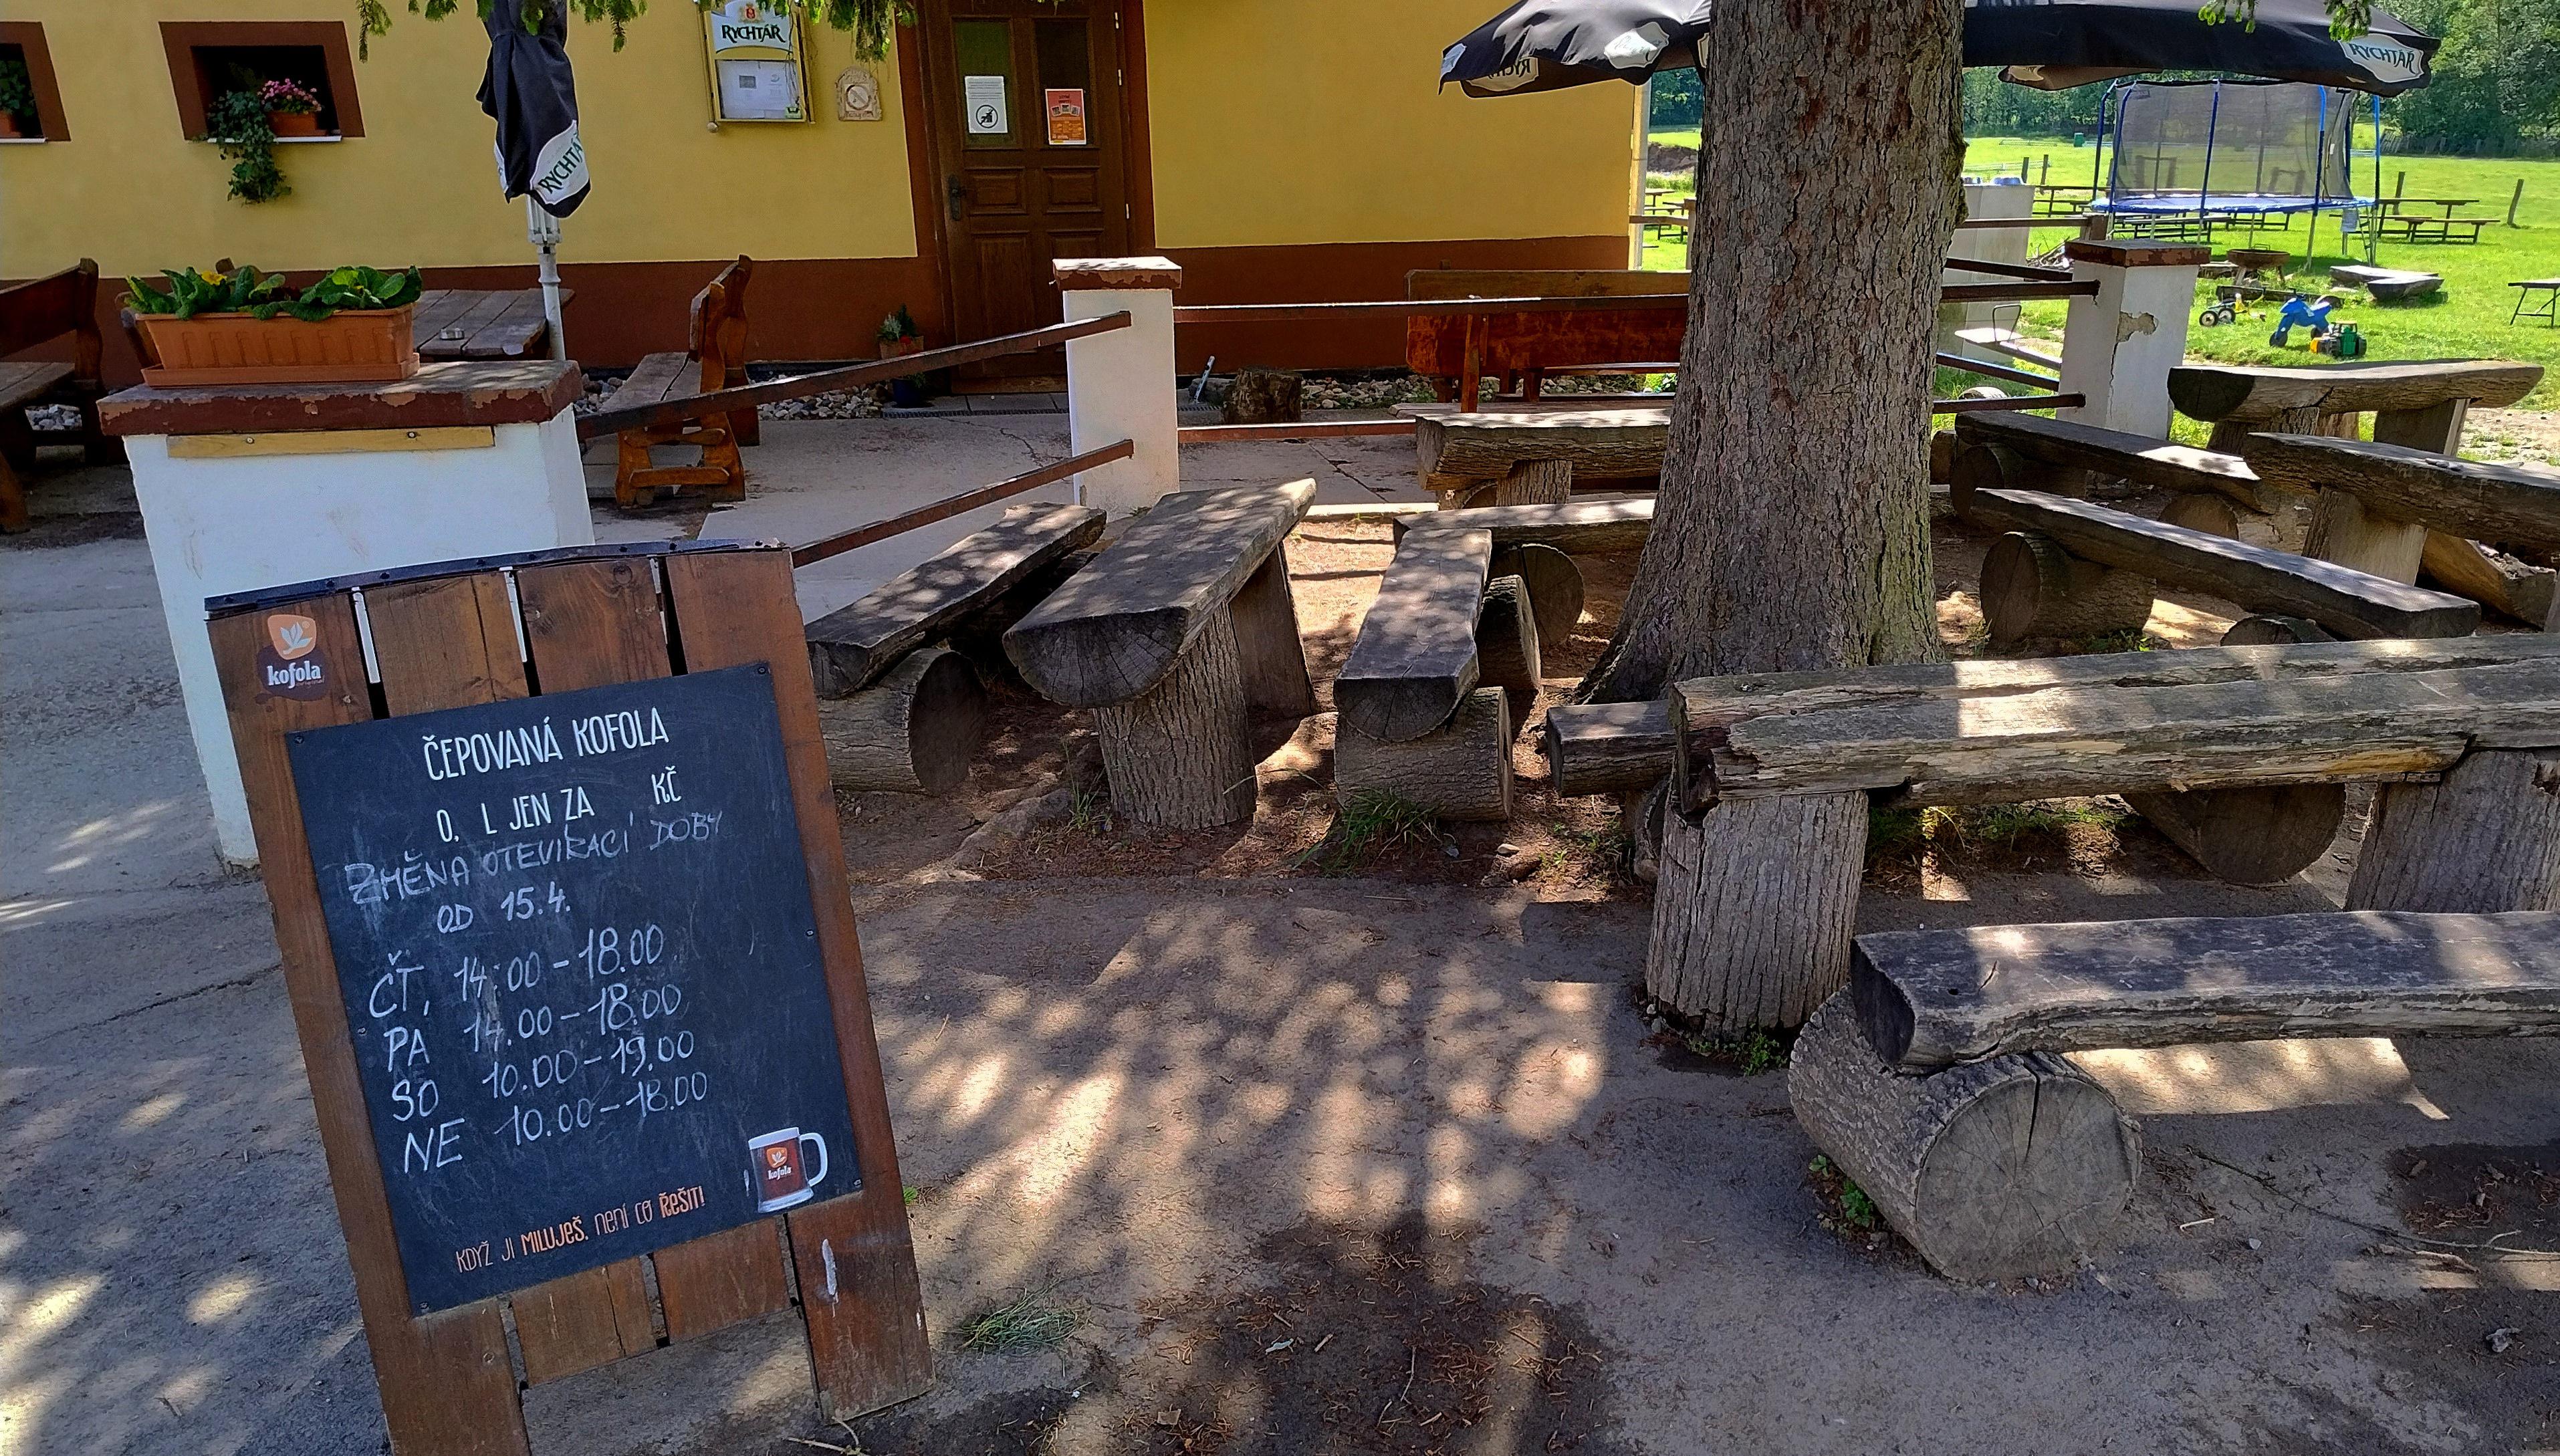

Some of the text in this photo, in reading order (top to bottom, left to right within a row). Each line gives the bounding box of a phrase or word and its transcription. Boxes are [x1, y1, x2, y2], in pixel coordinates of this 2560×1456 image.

[721, 24, 786, 43] RYCHTÁŘ
[2349, 43, 2416, 74] RYCHTÁŘ
[537, 132, 584, 195] RYCHTÁ
[266, 660, 322, 689] kofola
[422, 706, 669, 781] ČEPOVANÁ KOFOLA
[509, 792, 552, 831] JEN
[560, 785, 595, 822] ZA
[651, 765, 681, 805] KČ
[344, 849, 470, 904] ZMĚNA
[648, 810, 723, 851] DOBY
[437, 881, 571, 934] OD 15.4.
[392, 1079, 439, 1122] SO
[404, 1118, 465, 1175] NE
[768, 1165, 792, 1180] kofola
[455, 1240, 494, 1273] KDYŽ
[501, 1237, 516, 1262] JI
